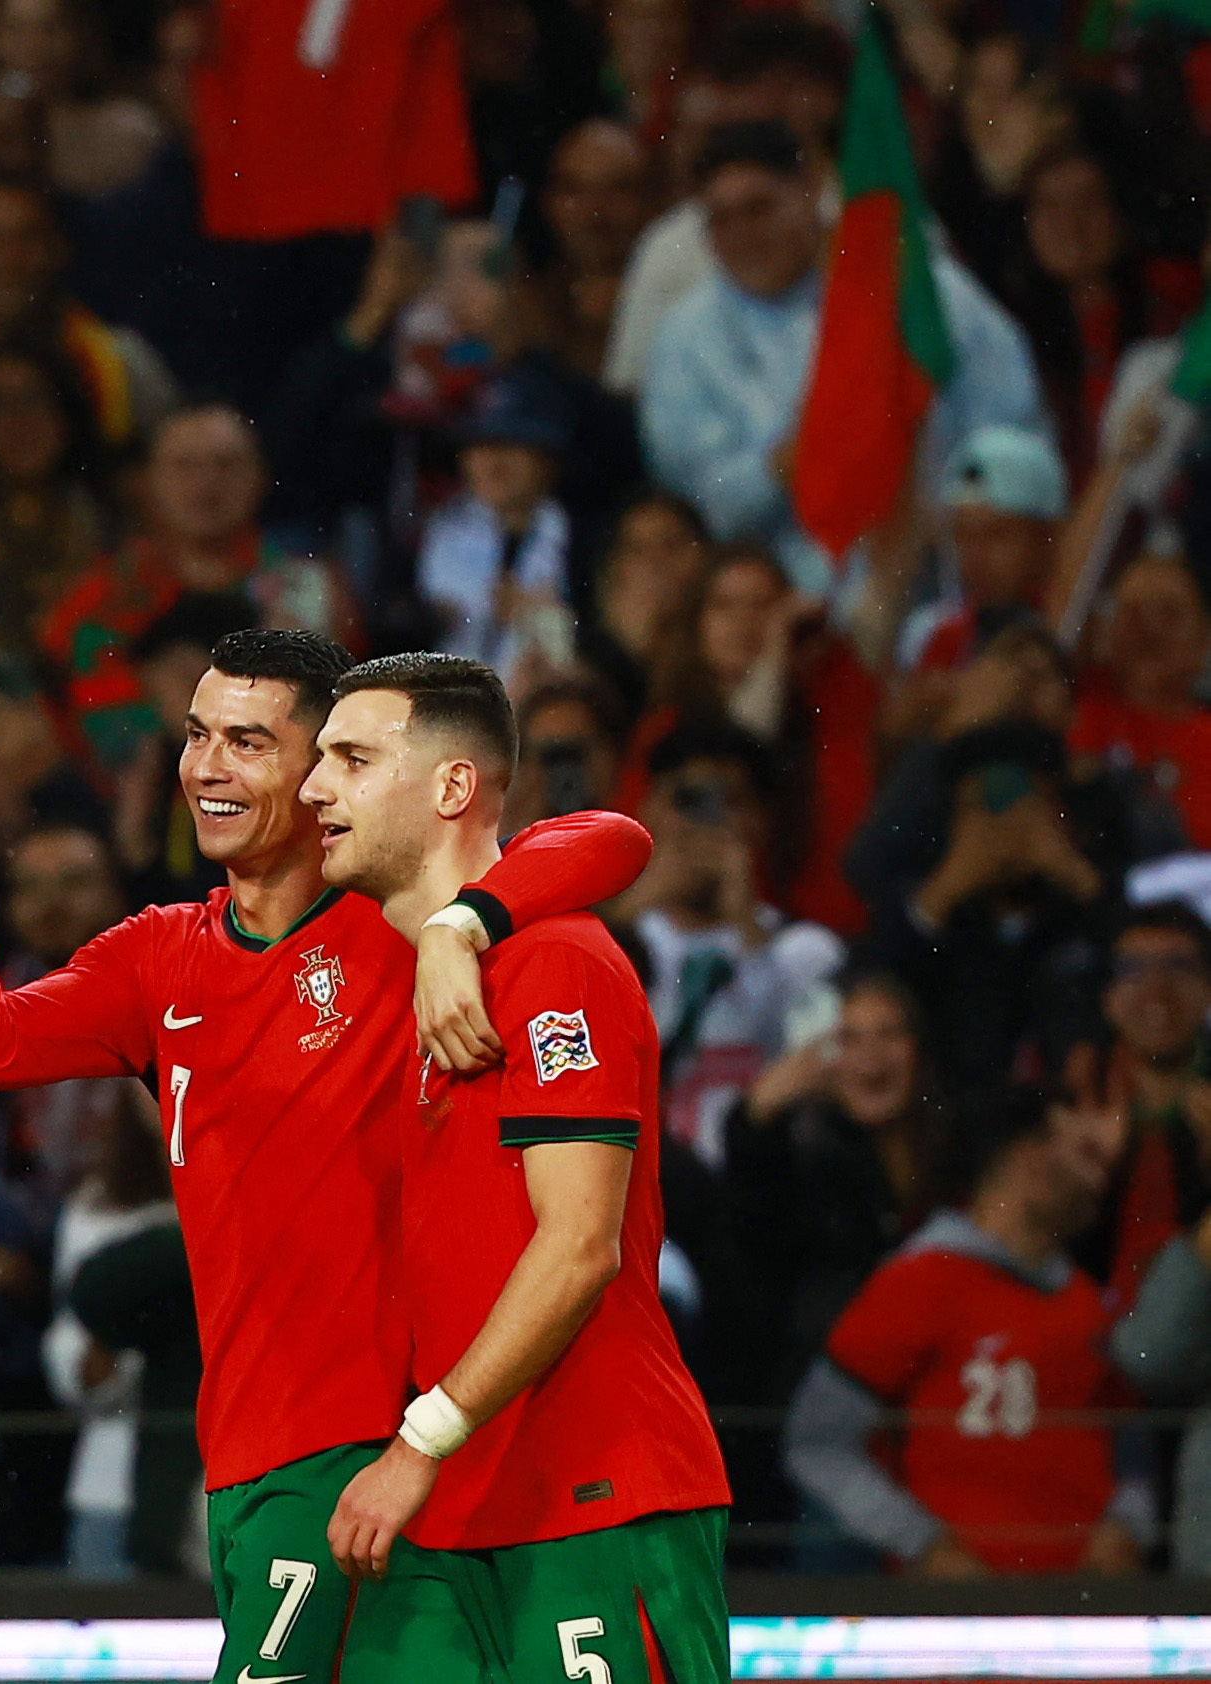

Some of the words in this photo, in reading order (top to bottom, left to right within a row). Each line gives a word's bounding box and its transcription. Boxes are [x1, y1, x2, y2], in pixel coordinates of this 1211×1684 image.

[170, 1064, 192, 1166] 7
[259, 1559, 317, 1660] 7
[557, 1616, 612, 1684] 5
